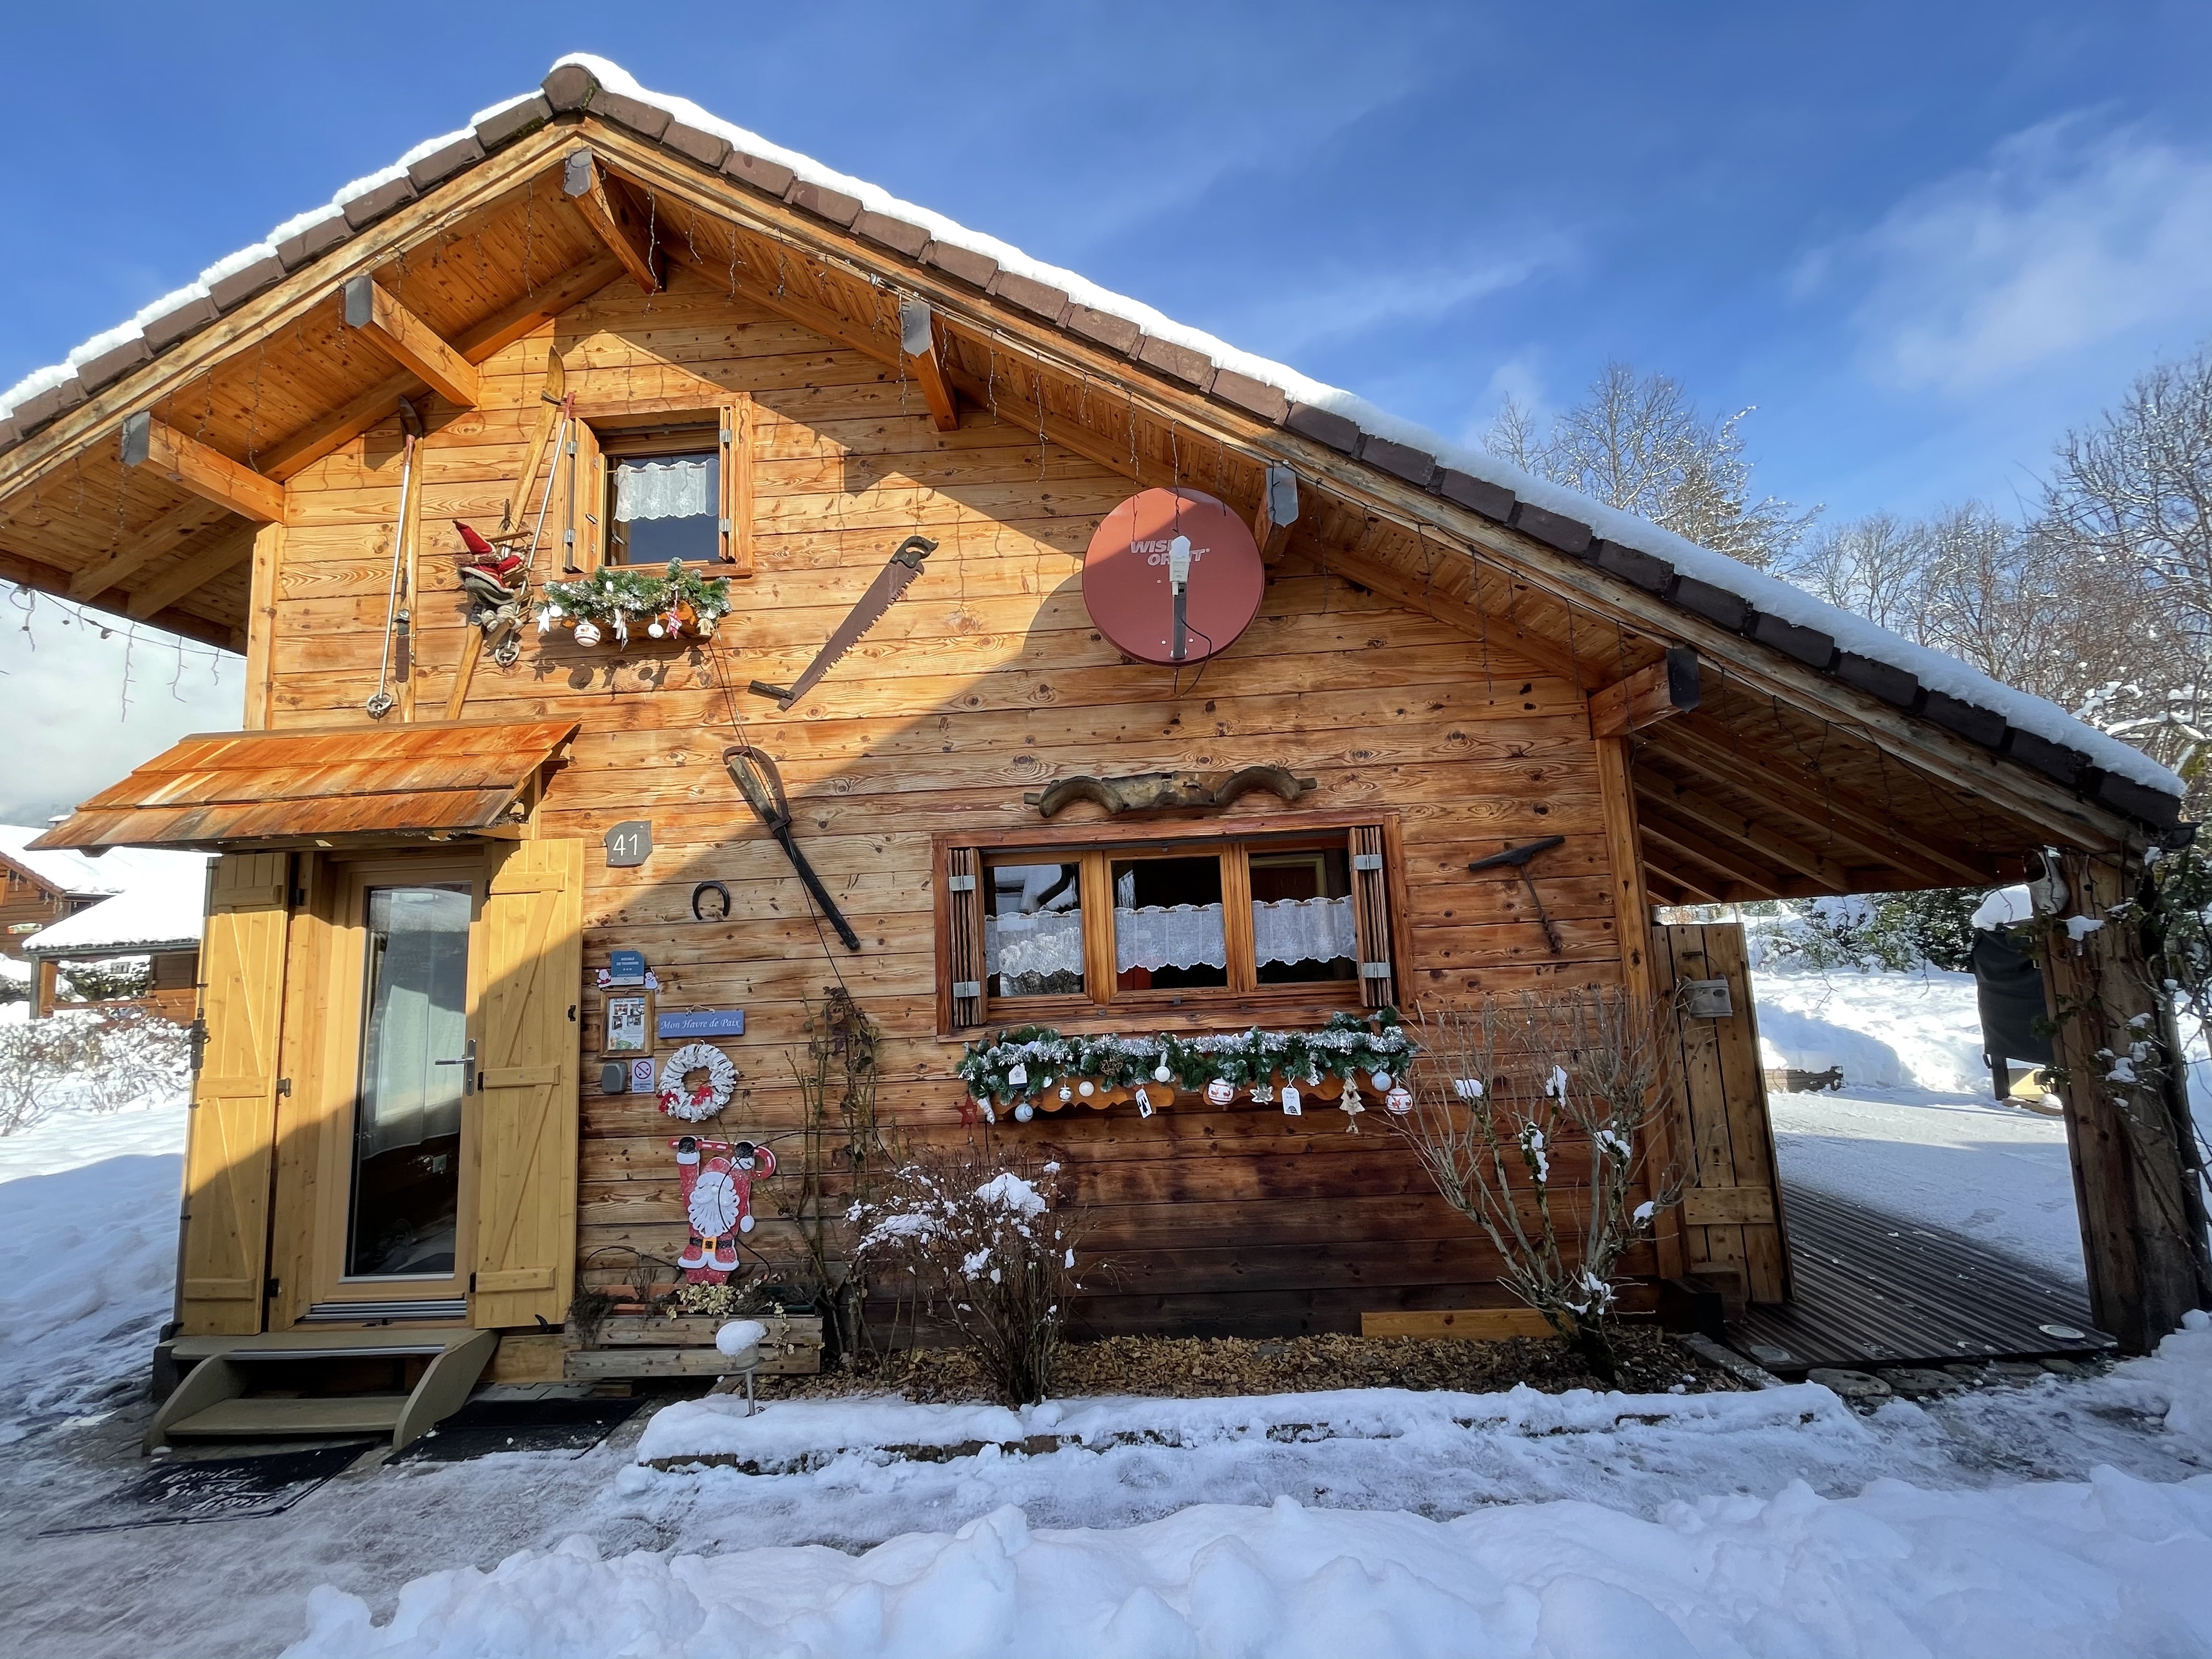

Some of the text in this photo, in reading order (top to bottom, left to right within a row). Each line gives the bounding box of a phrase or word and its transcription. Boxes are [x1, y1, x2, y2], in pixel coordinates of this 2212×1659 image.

[612, 833, 637, 856] 41
[660, 1018, 741, 1030] Mon Havre de Paix
